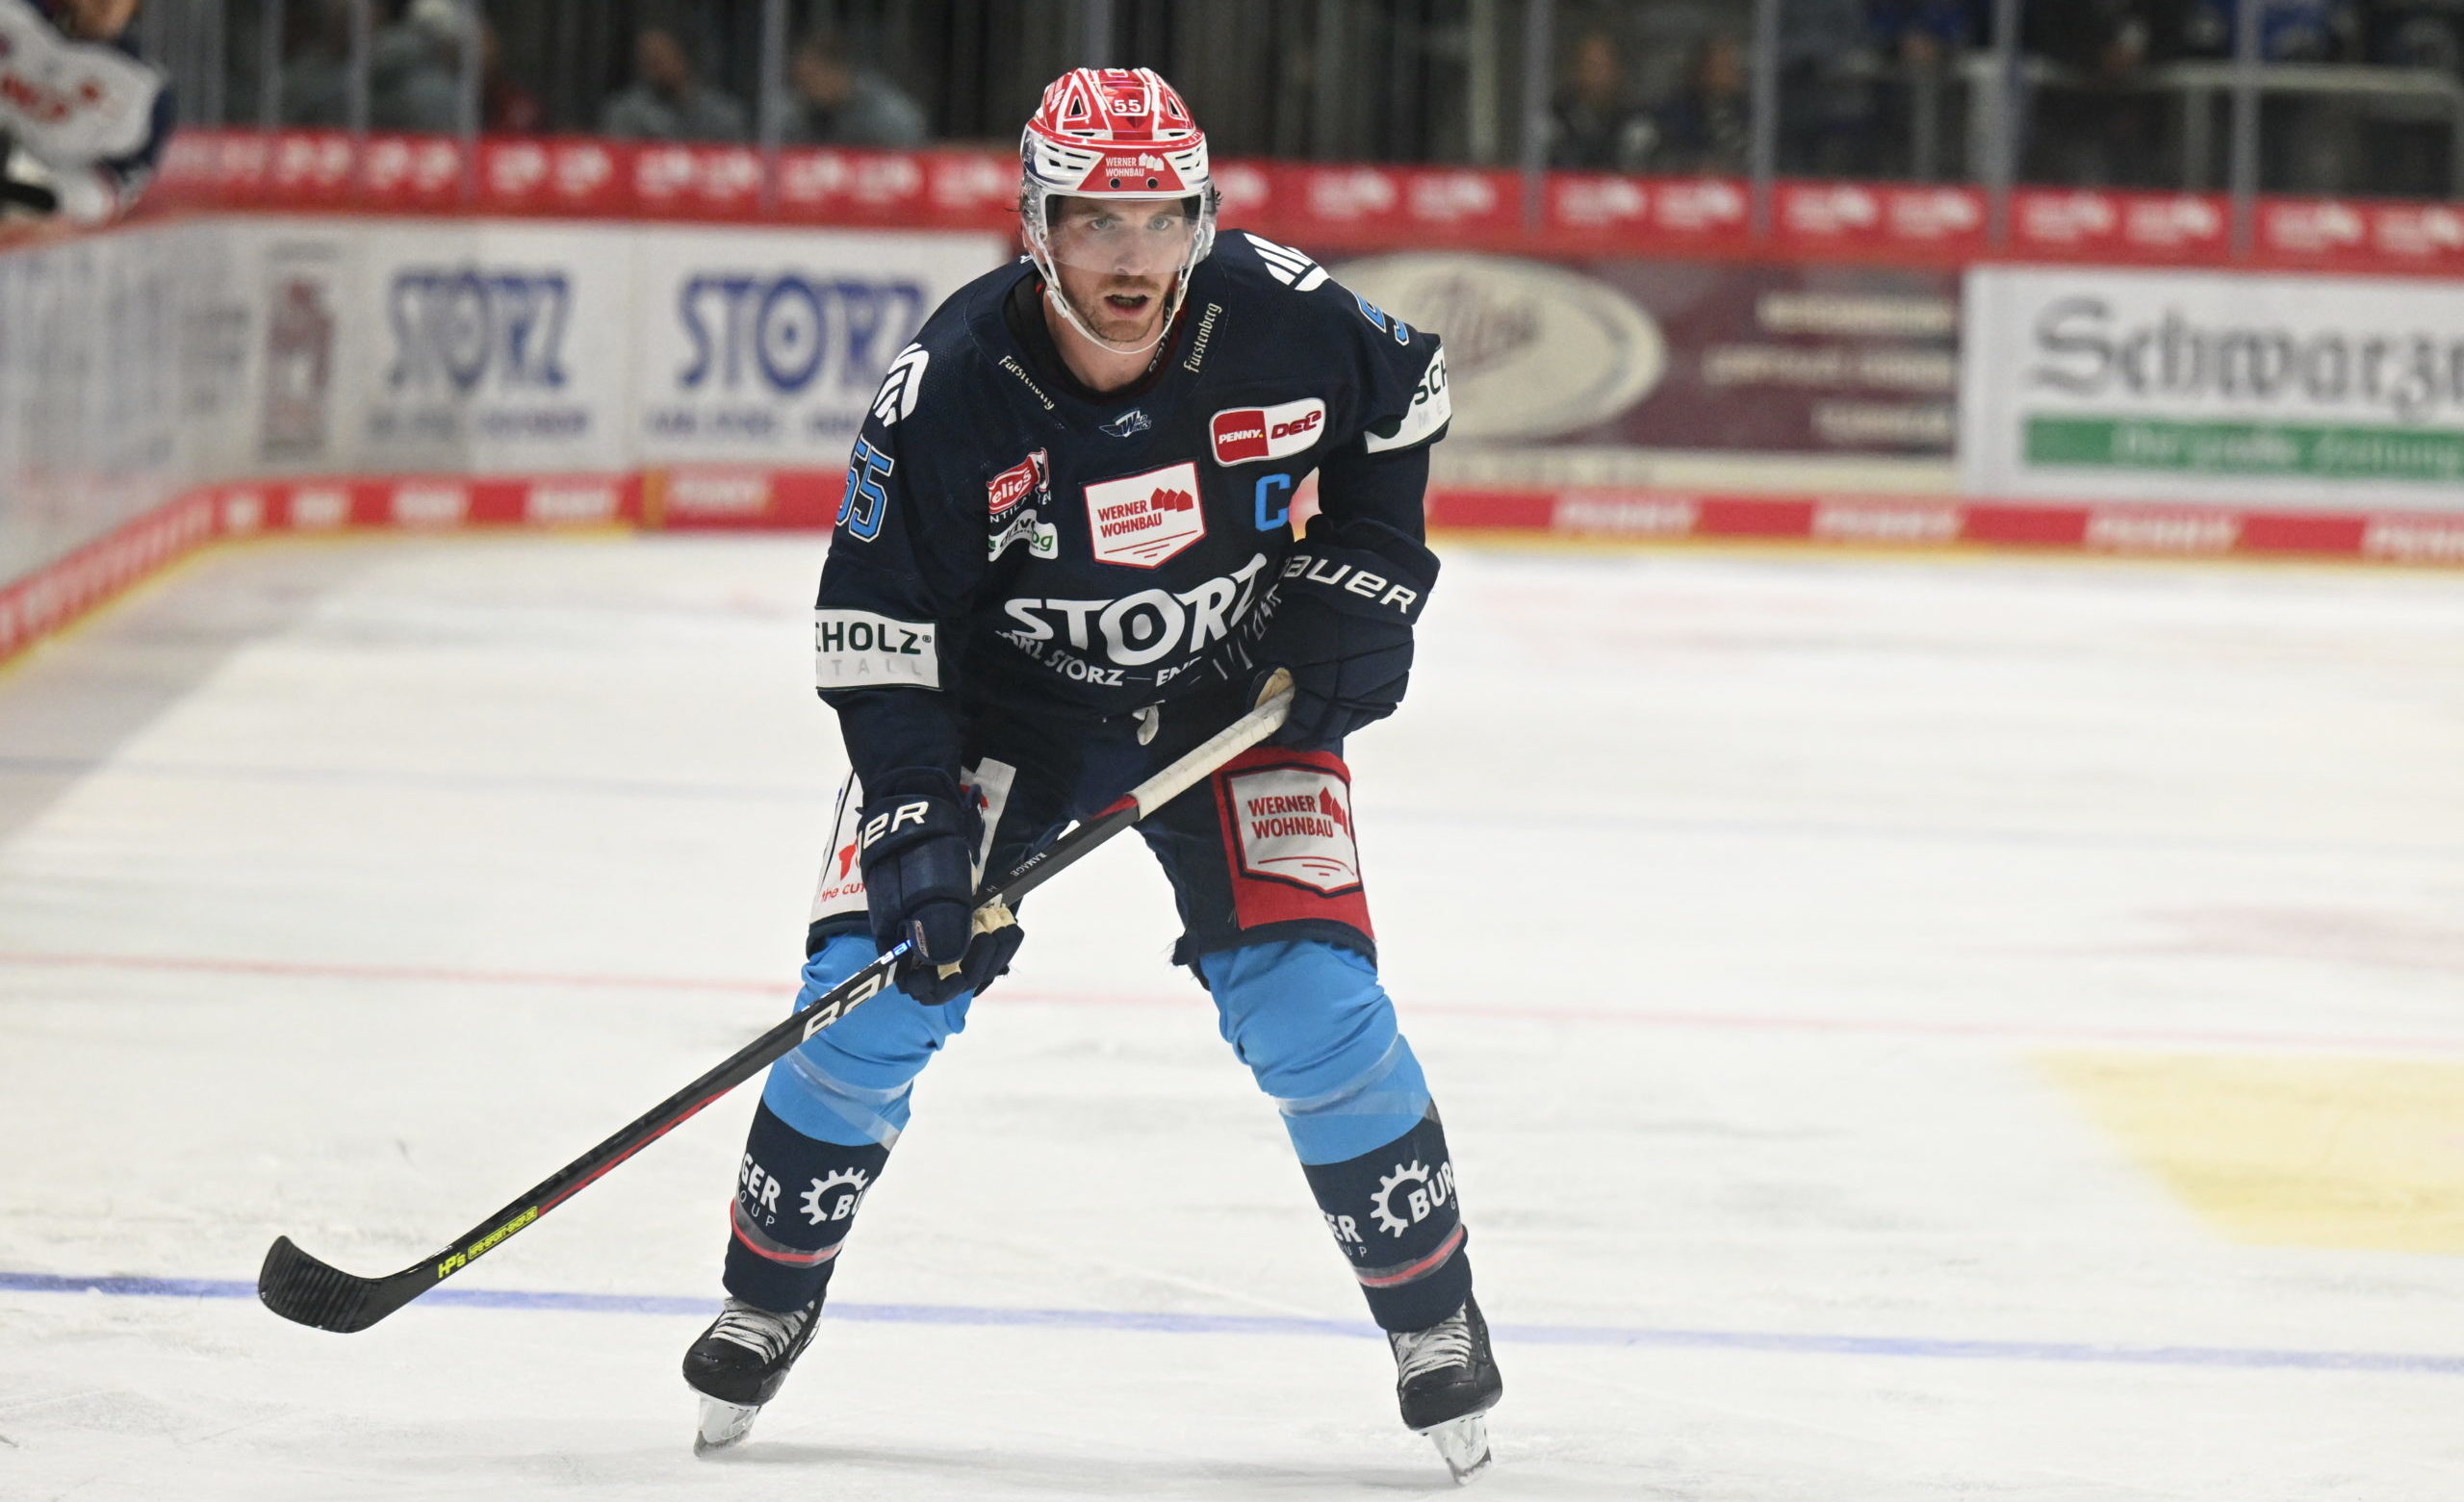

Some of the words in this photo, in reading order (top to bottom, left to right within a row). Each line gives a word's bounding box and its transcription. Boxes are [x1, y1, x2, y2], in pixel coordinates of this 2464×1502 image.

[1114, 99, 1142, 113] 55
[1106, 157, 1137, 166] WERNER
[1106, 167, 1144, 177] WOHNBAU
[2035, 293, 2464, 423] Schwarz
[835, 433, 895, 544] 55
[1097, 499, 1148, 522] WERNER
[1254, 472, 1291, 531] C
[1099, 511, 1163, 539] WOHNBAU
[1004, 552, 1268, 666] STORZ
[1044, 649, 1126, 687] STORZ
[1247, 795, 1318, 818] WERNER
[1251, 817, 1335, 840] WOHNBAU
